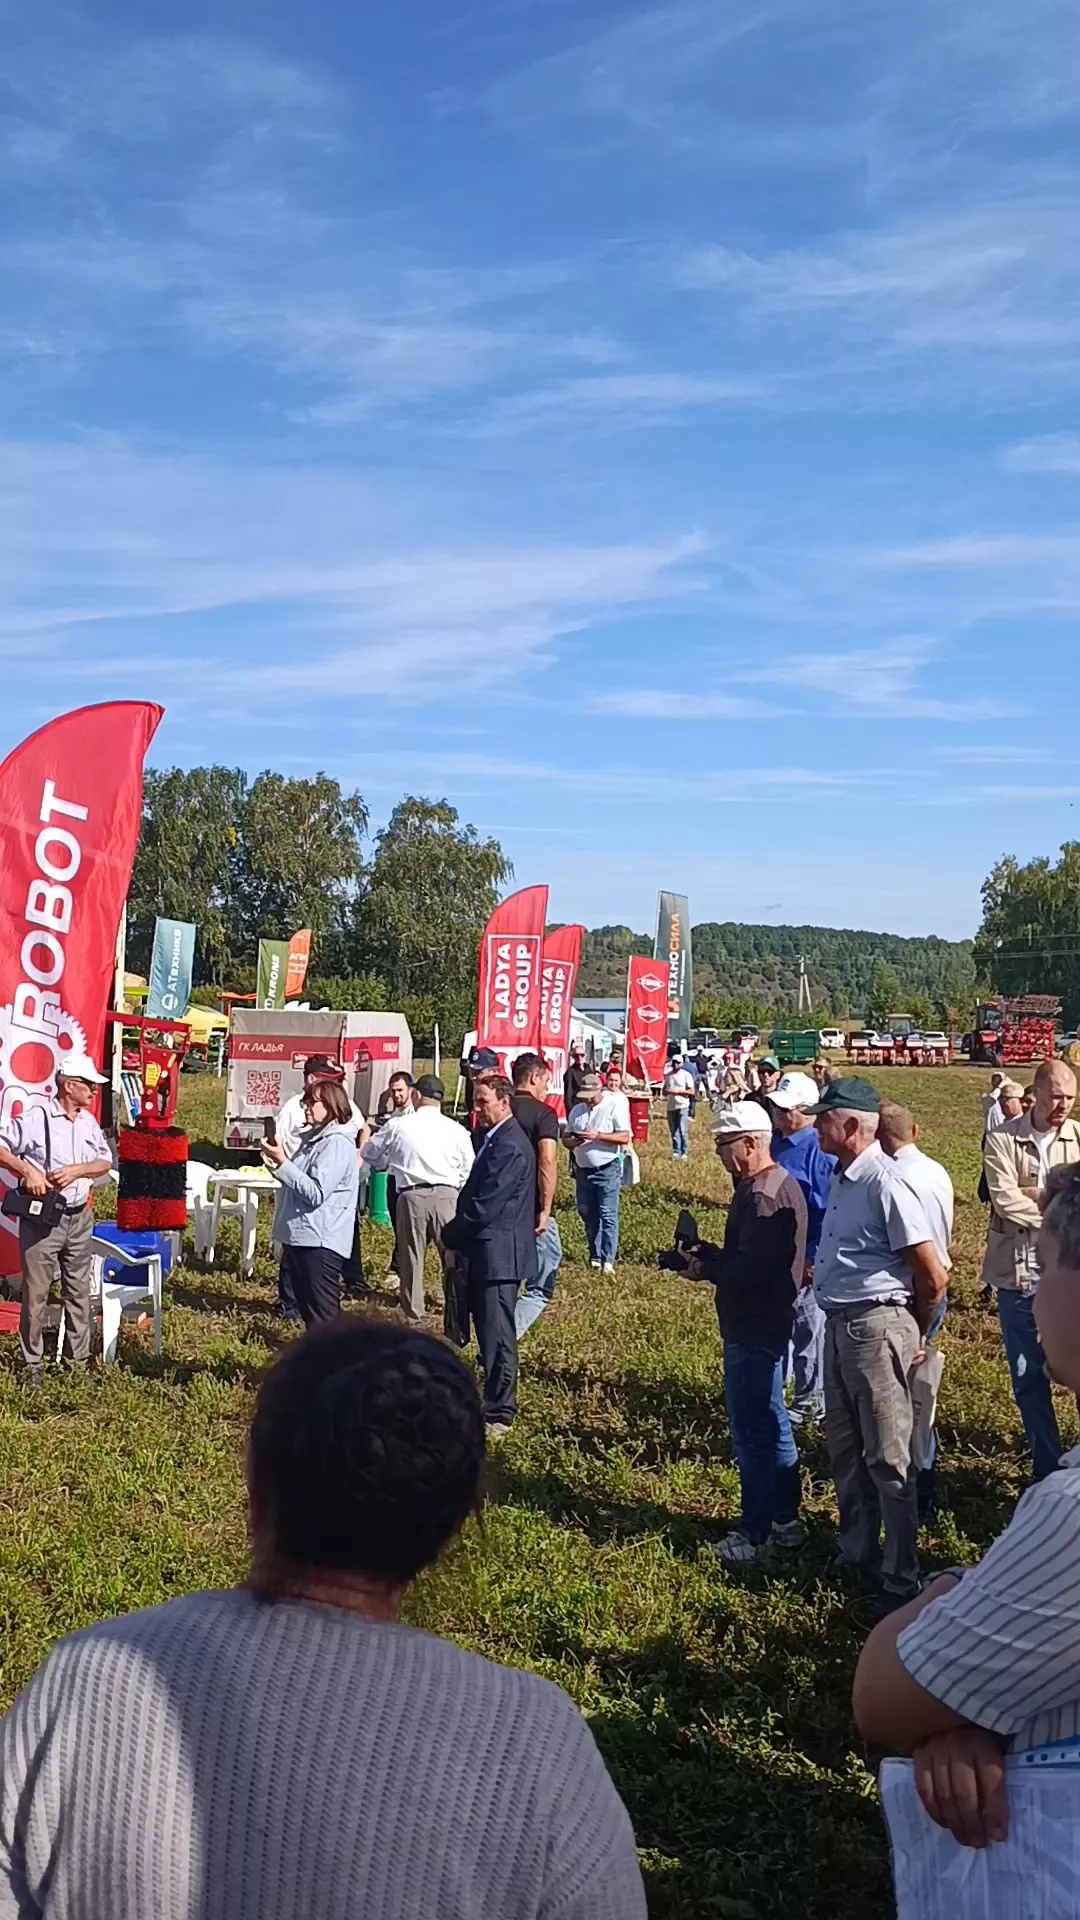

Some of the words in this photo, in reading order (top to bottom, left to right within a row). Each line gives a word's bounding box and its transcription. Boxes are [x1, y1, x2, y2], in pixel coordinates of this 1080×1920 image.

[268, 953, 280, 998] KRONE
[495, 943, 511, 1019] LADYA
[513, 944, 532, 1028] GROUP
[549, 968, 566, 1034] GROUP
